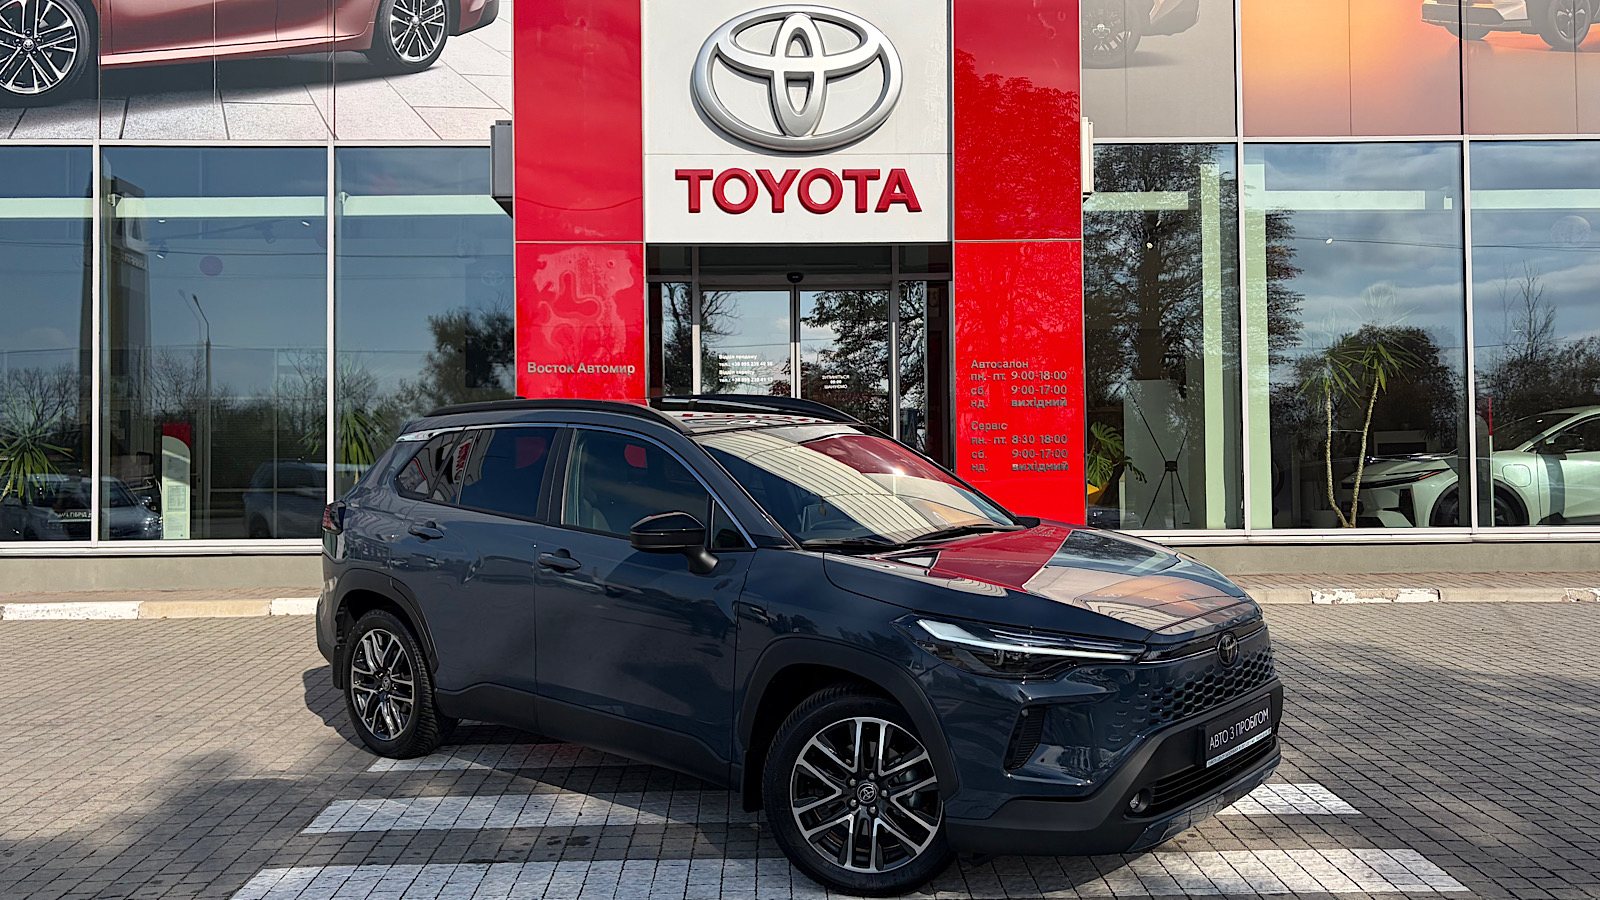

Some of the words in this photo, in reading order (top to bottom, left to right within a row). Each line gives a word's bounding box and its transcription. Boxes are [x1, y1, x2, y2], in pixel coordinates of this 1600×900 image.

[675, 167, 922, 214] TOYOTA
[527, 362, 574, 374] Восток
[577, 362, 636, 376] Автомир
[971, 360, 1029, 369] Автосалон
[1011, 371, 1067, 381] 9:00-18:00
[1011, 385, 1067, 395] 9:00-17:00
[970, 399, 988, 409] нд.
[1011, 397, 1068, 409] вихідний
[970, 421, 1008, 432] Сервіс
[971, 450, 987, 459] сб.
[1012, 449, 1068, 459] 9:00-17:00
[971, 463, 988, 473] нд.
[1012, 461, 1069, 473] вихідний
[1209, 729, 1229, 750] АВТО
[1235, 708, 1269, 737] ПРОБІГОМ
